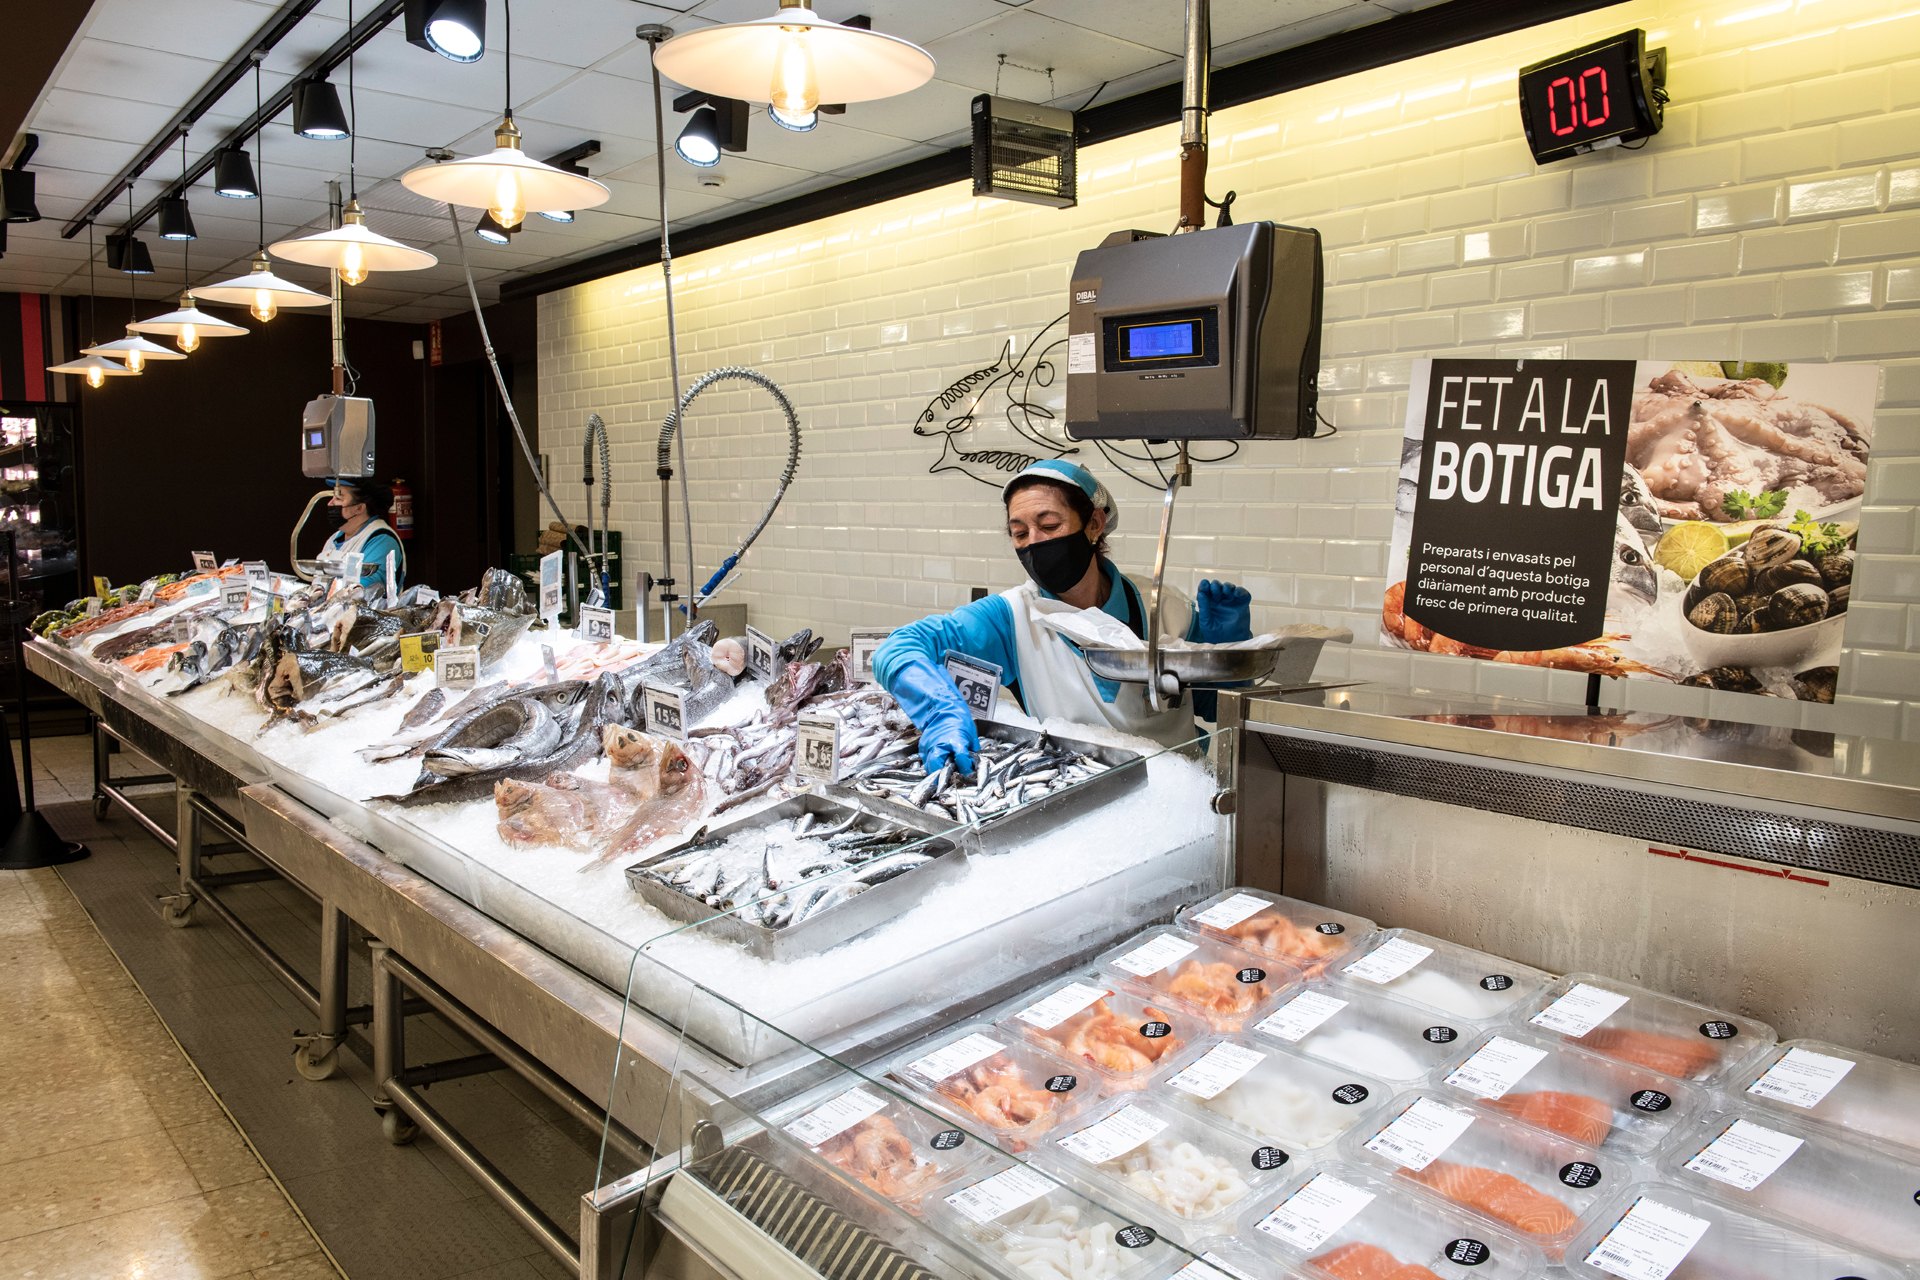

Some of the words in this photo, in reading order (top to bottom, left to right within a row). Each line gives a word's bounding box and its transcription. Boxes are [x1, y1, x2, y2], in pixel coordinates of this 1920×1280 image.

[1547, 66, 1610, 136] 00
[1076, 290, 1096, 300] DIBAL
[1437, 376, 1514, 430] FET
[1518, 377, 1546, 433] A
[1560, 378, 1611, 435] LA
[1429, 441, 1603, 511] BOTIGA
[1422, 542, 1484, 560] Preparats
[1486, 548, 1491, 560] i
[1492, 551, 1551, 565] envasats
[1553, 555, 1576, 569] pel
[1419, 562, 1475, 576] personal
[1545, 572, 1590, 590] botiga
[1417, 577, 1487, 596] diàriament
[1489, 586, 1519, 598] amb
[1521, 589, 1586, 606] producte
[1416, 594, 1447, 609] fresc
[1448, 598, 1466, 610] de
[1467, 601, 1519, 617] primera
[1521, 608, 1578, 624] qualitat.
[591, 620, 611, 637] 9,95
[447, 666, 474, 680] 32,99
[959, 679, 989, 708] 6,95
[1564, 1163, 1585, 1183] BOTIGA
[1583, 1166, 1595, 1176] FET
[1451, 1240, 1470, 1260] BOTIGA
[1469, 1243, 1482, 1253] FET
